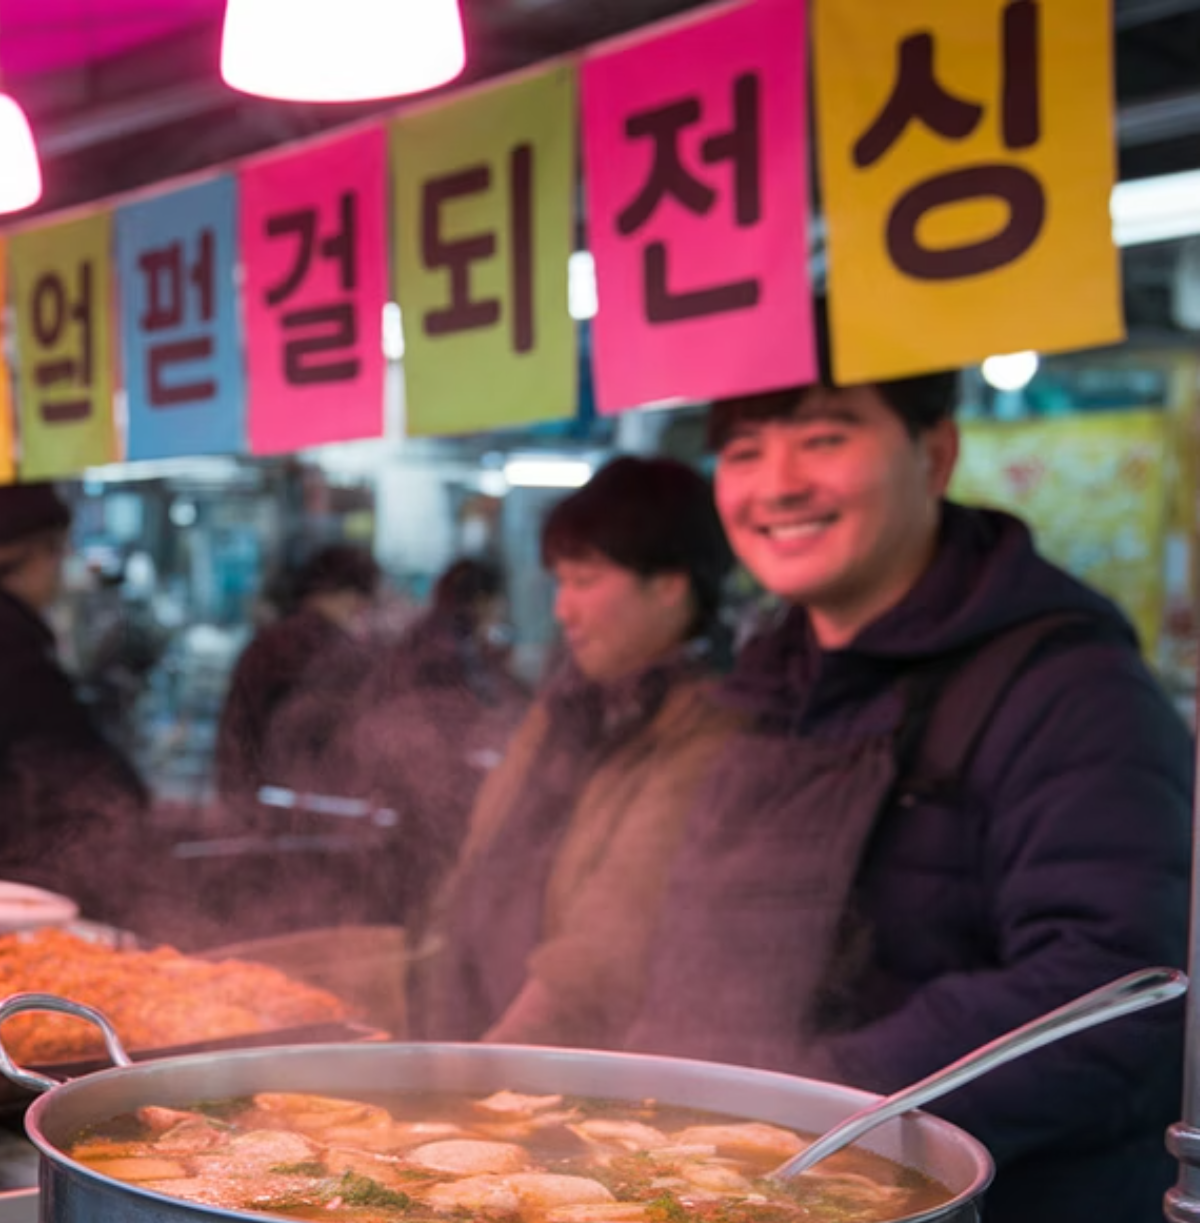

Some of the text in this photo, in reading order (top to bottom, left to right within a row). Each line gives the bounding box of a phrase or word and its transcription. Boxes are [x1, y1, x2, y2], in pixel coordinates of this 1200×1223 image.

[419, 141, 536, 355] 되
[613, 69, 762, 327] 전
[849, 0, 1048, 282] 싱
